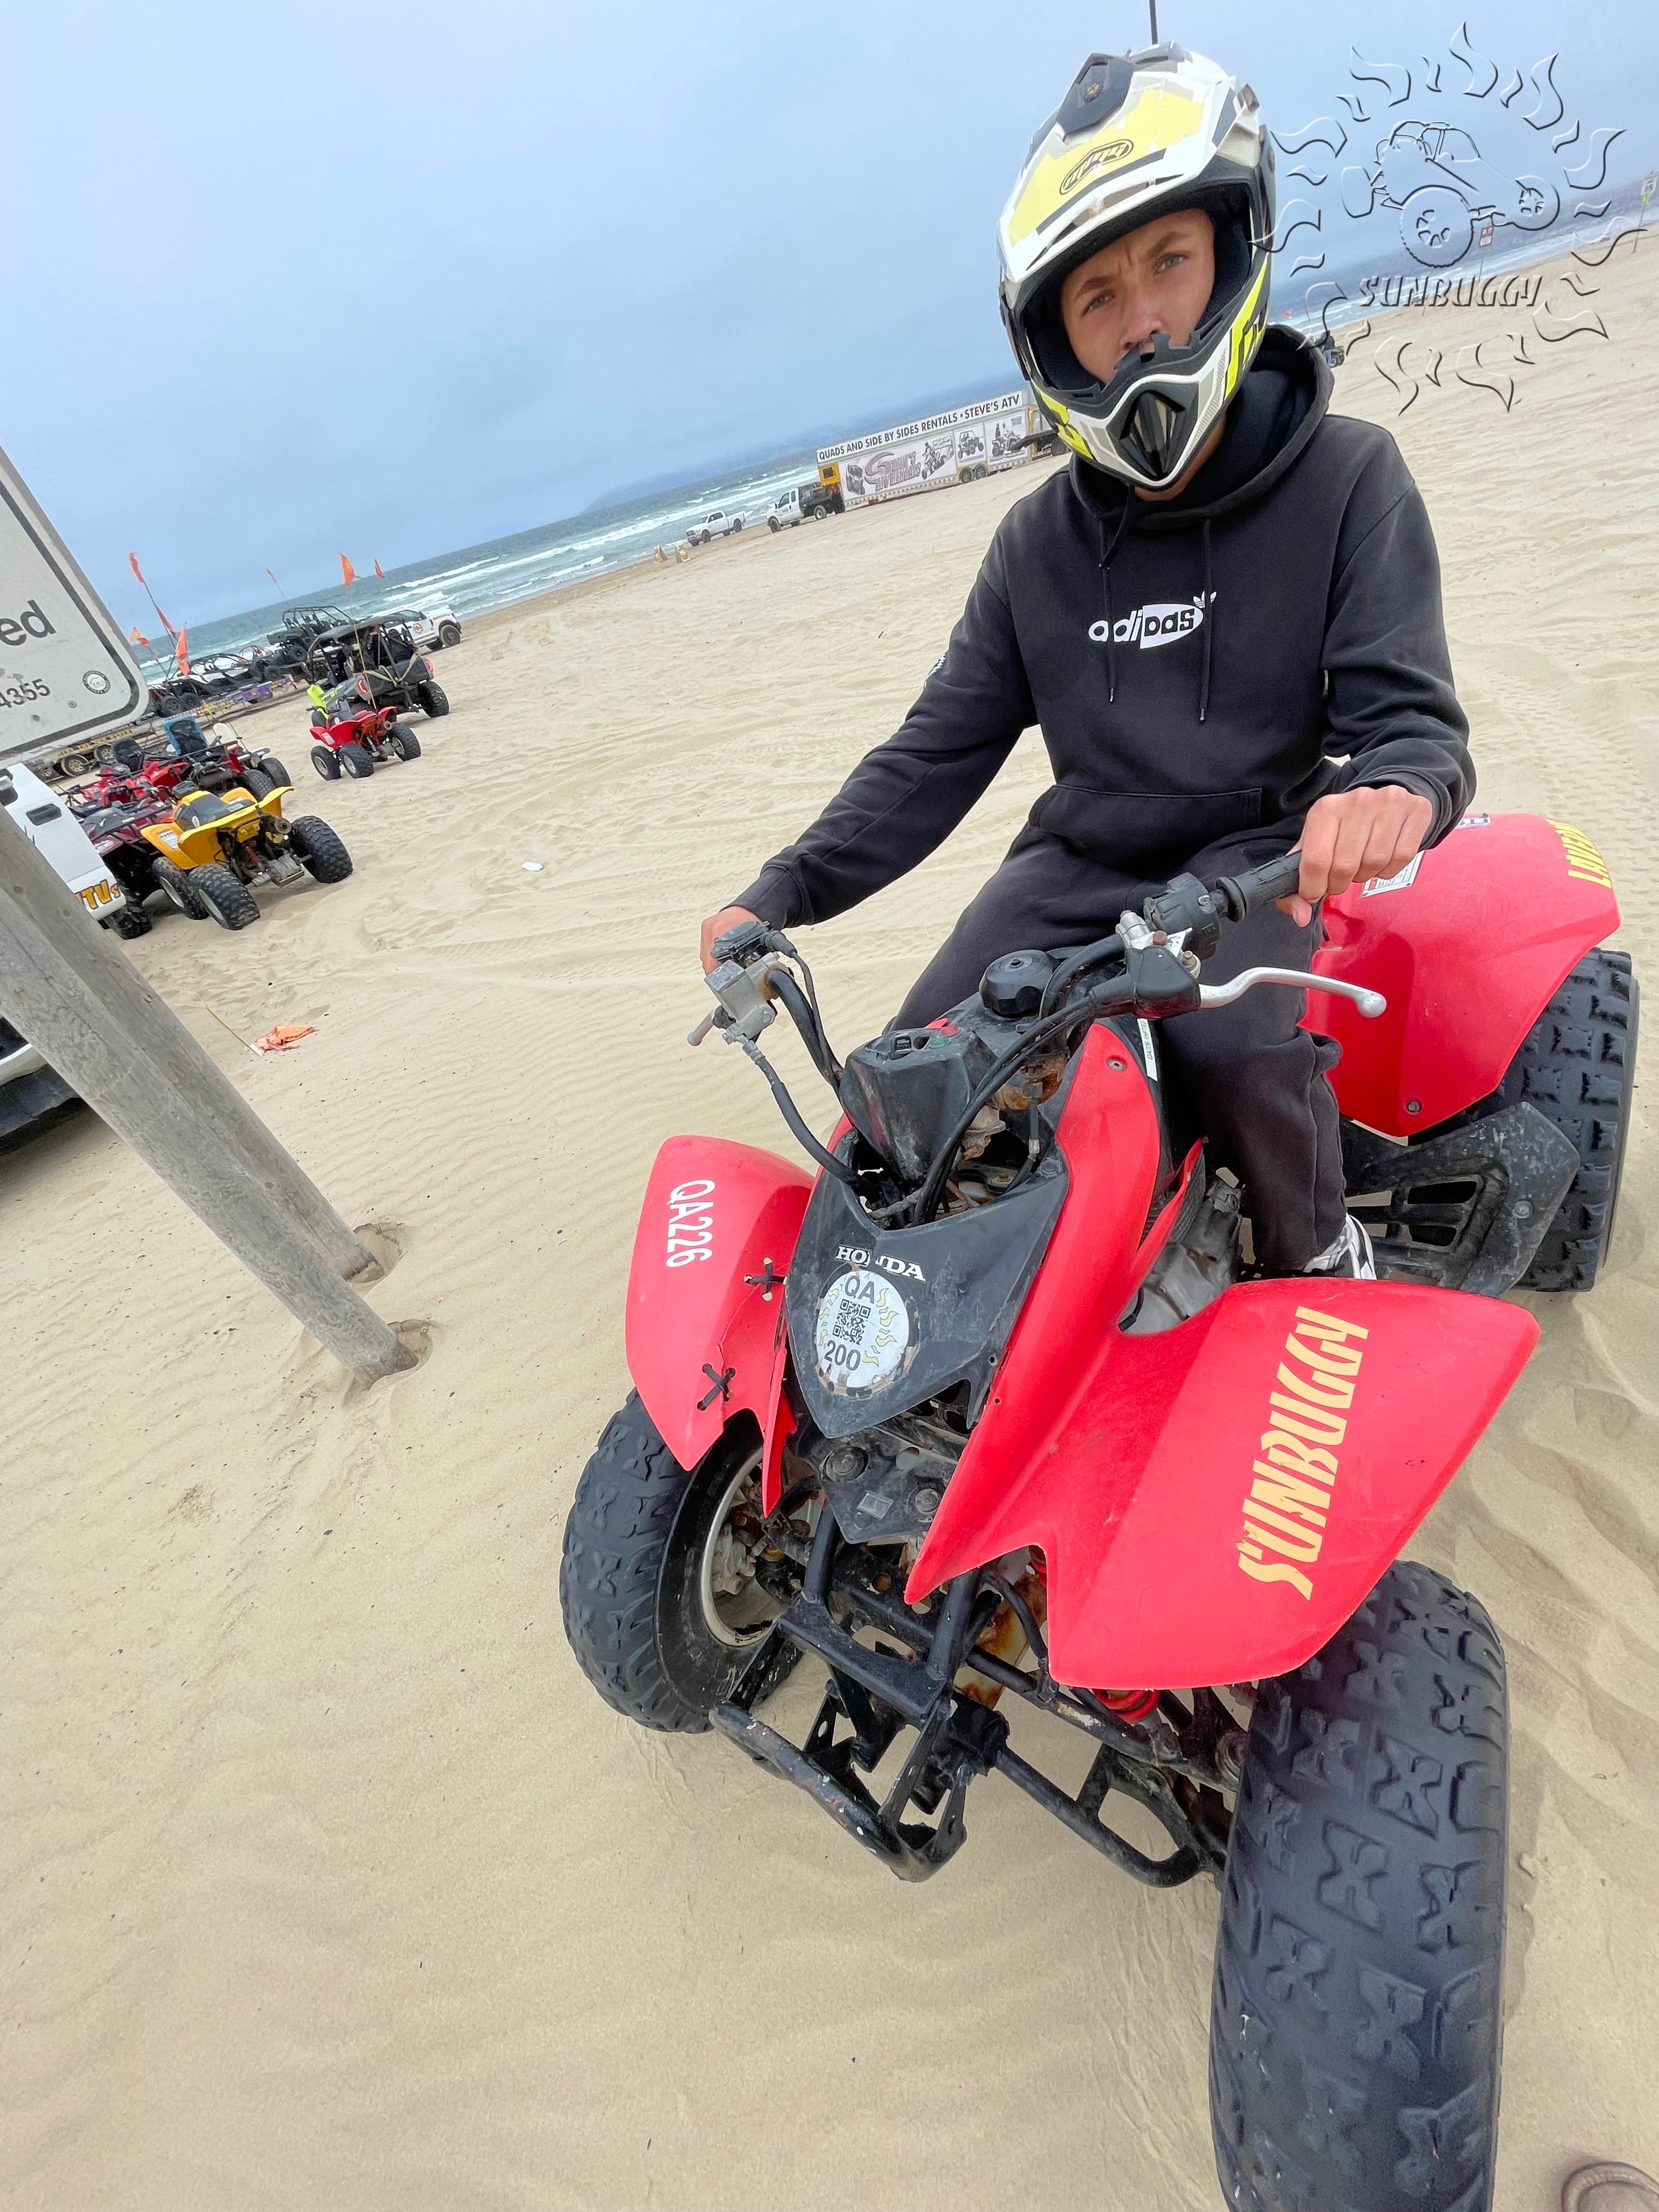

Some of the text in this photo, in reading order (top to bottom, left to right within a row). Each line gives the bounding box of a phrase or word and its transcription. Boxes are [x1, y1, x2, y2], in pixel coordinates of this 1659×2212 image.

[819, 394, 1019, 460] QUADS AND SIDE BY SIDES RENTALS STEVE'S ATV
[74, 879, 121, 910] TVs
[665, 1179, 716, 1268] QA226
[845, 1275, 876, 1304] QA
[824, 1340, 861, 1372] 200
[1236, 1306, 1369, 1601] SUNBUGGY
